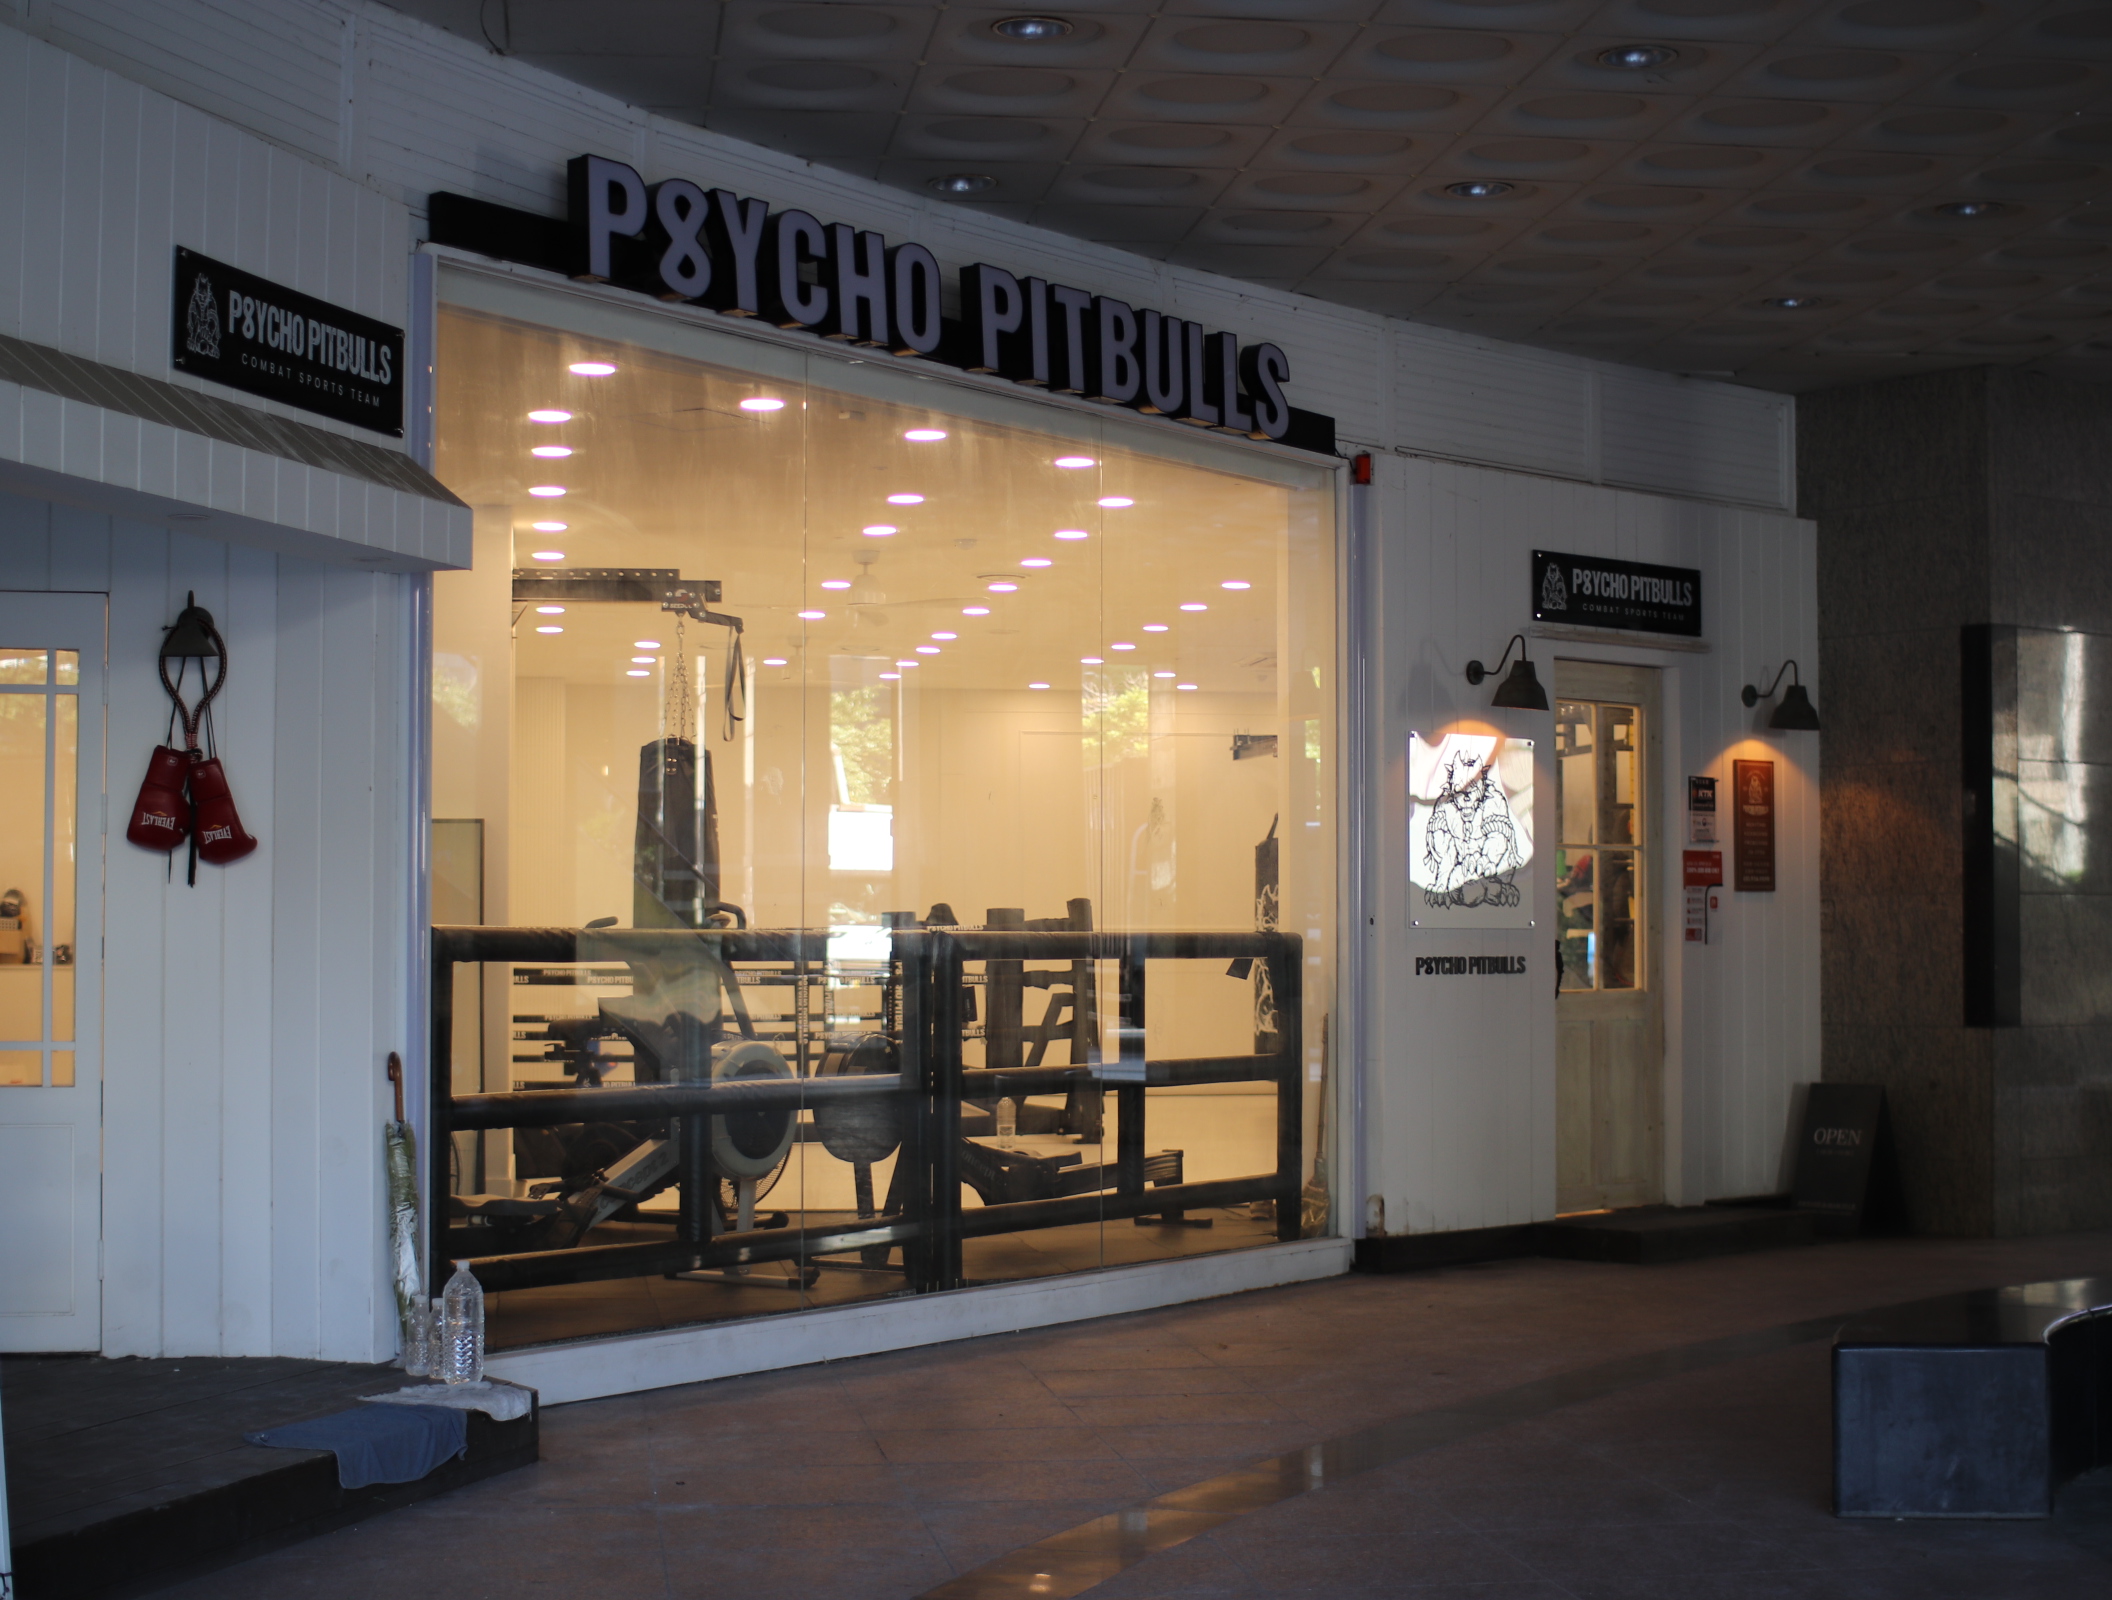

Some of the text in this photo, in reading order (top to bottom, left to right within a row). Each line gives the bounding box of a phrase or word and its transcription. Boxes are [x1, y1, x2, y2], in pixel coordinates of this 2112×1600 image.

[307, 318, 393, 386] PITBULLS
[963, 263, 1291, 440] PITBULLS
[241, 353, 381, 407] COMBAT SPORTS TEAM
[1631, 575, 1693, 607] PITBULLS
[1582, 603, 1685, 622] COMBAT SPORTS TEAM
[141, 811, 176, 831] EVERLAST
[203, 825, 232, 844] EVERLAST
[1468, 955, 1527, 975] PITBULLS
[1813, 1126, 1863, 1147] OPEN
